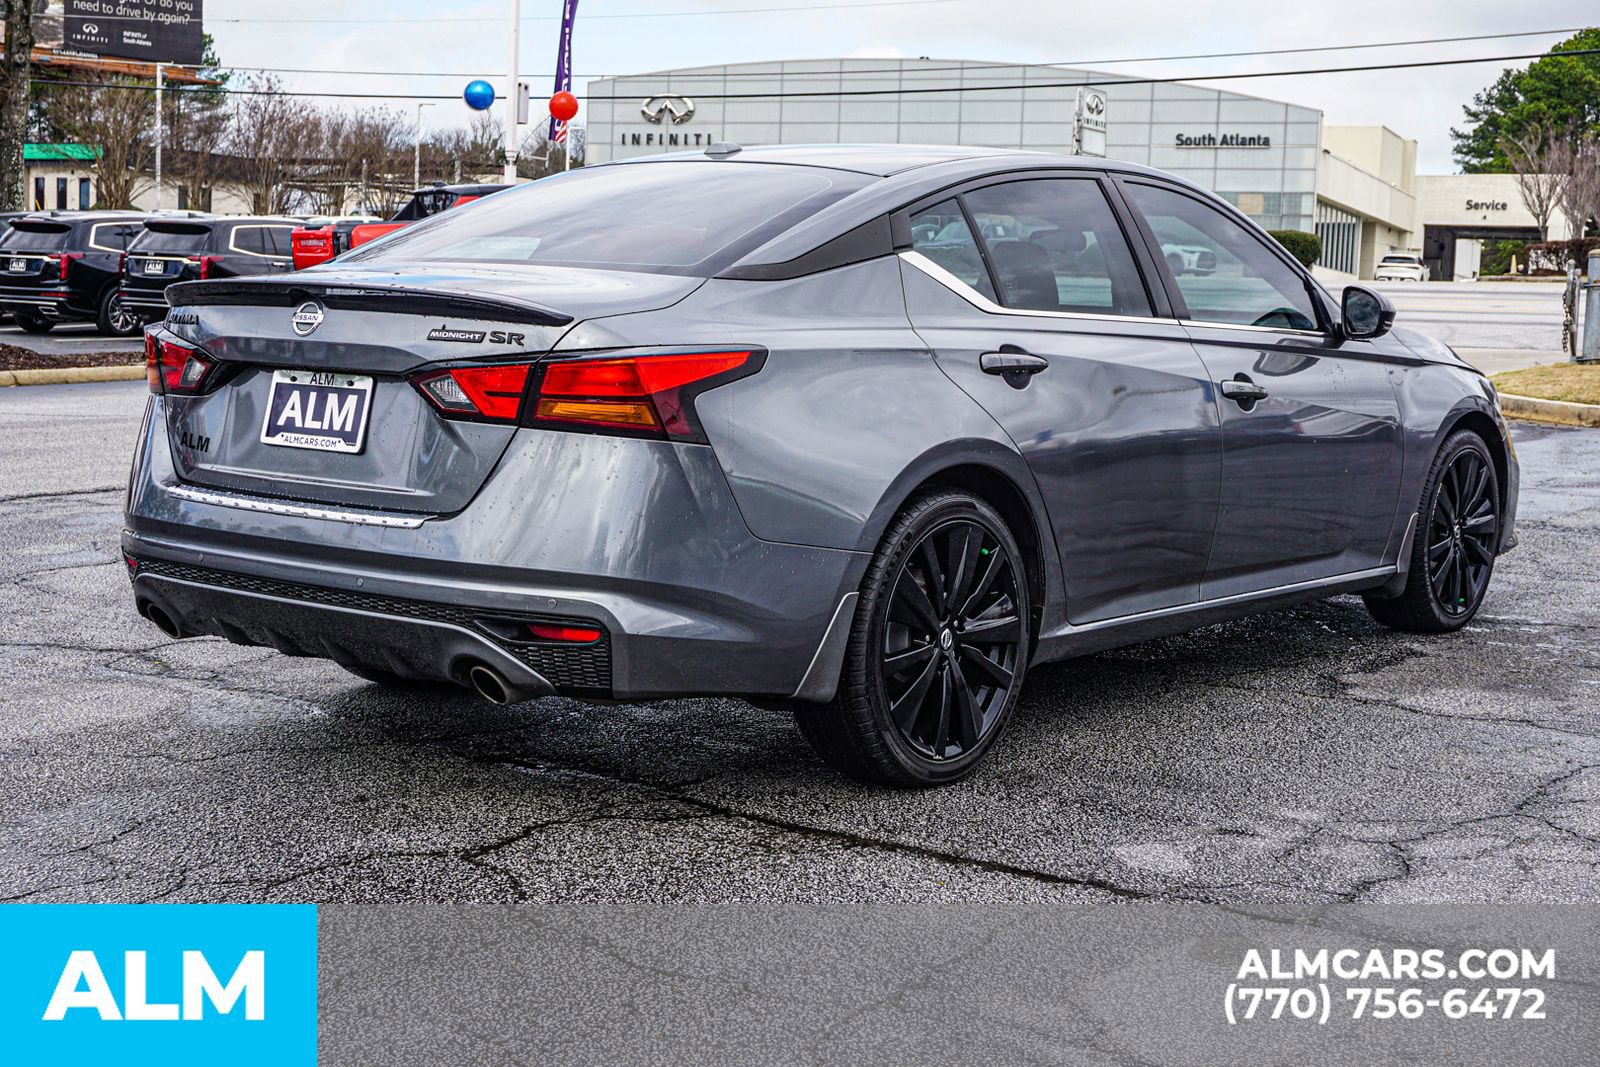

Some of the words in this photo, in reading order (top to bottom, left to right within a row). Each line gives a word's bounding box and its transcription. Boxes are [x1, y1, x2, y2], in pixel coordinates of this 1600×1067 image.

[160, 0, 173, 8] do
[175, 1, 193, 11] you
[73, 0, 99, 12] need
[102, 4, 114, 14] to
[116, 4, 141, 18] drive
[143, 7, 156, 22] by
[158, 11, 190, 25] again?
[72, 33, 108, 43] INFINITI
[621, 133, 711, 146] INFINITI
[1175, 132, 1216, 146] South
[1219, 132, 1270, 146] Atlanta
[1465, 199, 1508, 211] Service
[147, 262, 162, 271] ALM
[293, 313, 319, 321] NISSAN
[428, 328, 483, 342] MIDNIGHT
[488, 330, 526, 346] SR
[309, 373, 336, 386] ALM
[276, 390, 359, 432] ALM
[180, 431, 211, 453] ALM
[283, 434, 338, 448] ALMCARS.COM
